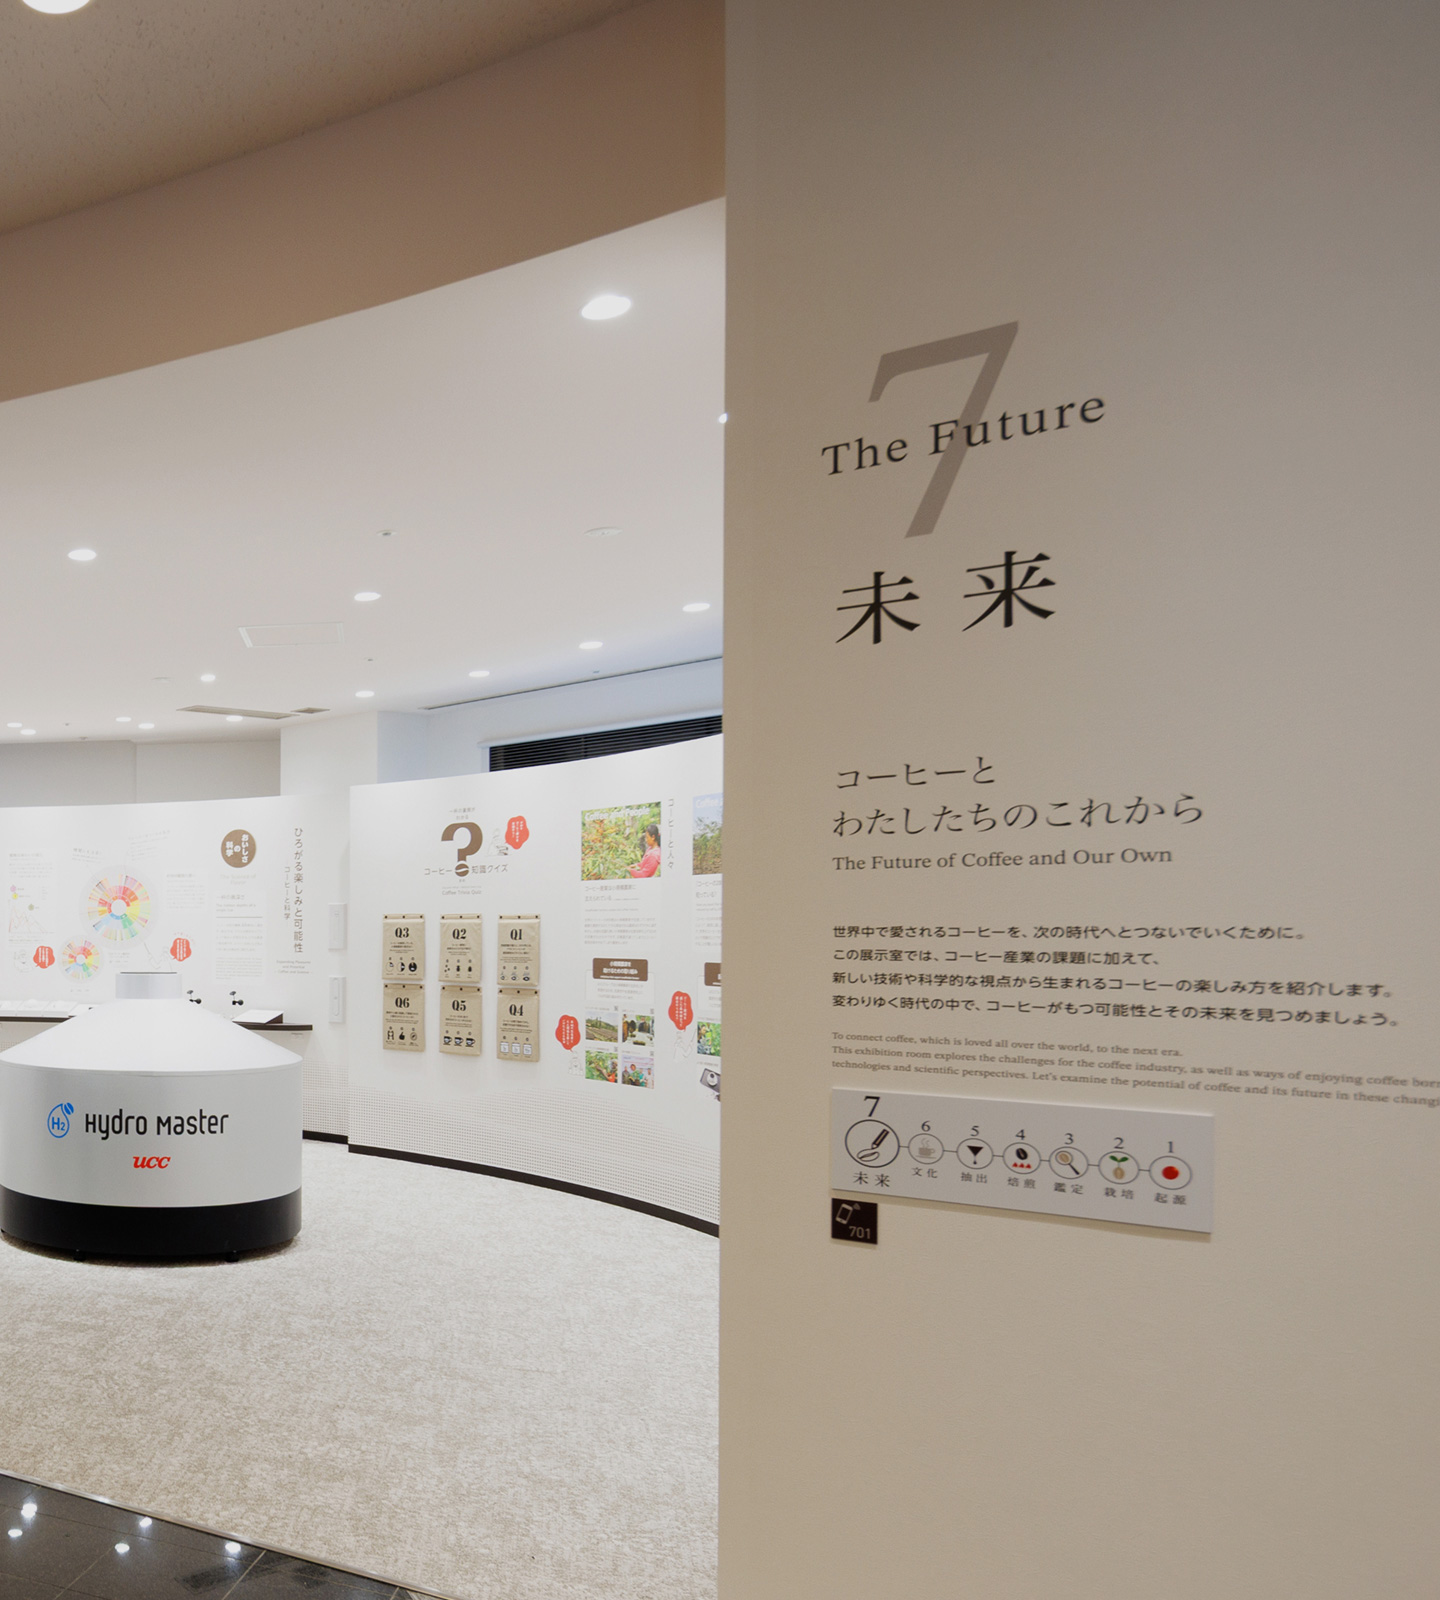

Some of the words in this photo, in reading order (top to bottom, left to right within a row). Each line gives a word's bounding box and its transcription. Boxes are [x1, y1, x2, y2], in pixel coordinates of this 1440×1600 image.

[821, 437, 909, 476] The
[928, 396, 1106, 456] Future
[868, 321, 1018, 539] 7
[835, 550, 1057, 644] 未来
[836, 756, 995, 789] コーヒーと
[585, 811, 609, 821] Coffee
[832, 793, 1203, 838] わたしたちのこれから
[241, 833, 249, 863] おいしさ
[832, 857, 866, 871] The
[871, 854, 932, 869] Future
[937, 853, 956, 868] of
[961, 852, 1023, 868] Coffee
[1029, 850, 1066, 866] and
[1073, 849, 1114, 865] Our
[1120, 848, 1173, 863] Own
[424, 867, 453, 876] コーヒー
[293, 827, 303, 953] ひろがる楽しみと可能性
[442, 888, 456, 896] Coffee
[395, 927, 410, 939] Q3
[452, 928, 467, 940] Q2
[510, 928, 522, 941] Q1
[833, 925, 1305, 940] 世界中で愛されるコーヒーを、次の時代へとつないでいくために。
[833, 949, 1160, 965] この展示室では、コーヒー産業の課題に加えて、
[832, 971, 1392, 998] 新しい技術や科学的な視点から生まれるコーヒーの楽しみ方を紹介します。
[395, 997, 410, 1009] Q6
[452, 1000, 467, 1011] Q5
[509, 1004, 524, 1016] Q4
[832, 995, 1398, 1027] 変わりゆく時代の中で、コーヒーがもつ可能性とその未来を見つめましょう。
[832, 1032, 843, 1040] To
[846, 1034, 882, 1042] connect
[885, 1034, 917, 1044] coffee,
[920, 1036, 950, 1046] which
[954, 1037, 962, 1046] is
[965, 1038, 992, 1047] loved
[995, 1039, 1008, 1048] all
[1037, 1041, 1055, 1050] the
[1057, 1043, 1093, 1053] world,
[1096, 1045, 1108, 1053] to
[1111, 1045, 1129, 1054] the
[1133, 1047, 1158, 1055] next
[1161, 1049, 1183, 1057] era.
[832, 1046, 852, 1054] This
[855, 1047, 903, 1057] exhibition
[906, 1051, 931, 1059] room
[934, 1052, 976, 1062] explores
[979, 1053, 995, 1062] the
[998, 1055, 1055, 1067] challenges
[1057, 1057, 1074, 1066] for
[1077, 1058, 1095, 1068] the
[1098, 1060, 1132, 1070] coffee
[1135, 1062, 1188, 1075] industry,
[1190, 1066, 1203, 1074] as
[1207, 1067, 1232, 1076] well
[1236, 1069, 1249, 1077] as
[1252, 1070, 1284, 1080] ways
[1287, 1071, 1302, 1080] of
[1305, 1073, 1363, 1086] enjoying
[1366, 1076, 1408, 1086] coffee
[832, 1061, 891, 1072] technologies
[893, 1064, 911, 1072] and
[914, 1065, 959, 1075] scientific
[962, 1068, 1029, 1080] perspectives.
[1060, 1075, 1108, 1084] examine
[1111, 1076, 1129, 1086] the
[1132, 1078, 1185, 1090] potential
[1188, 1081, 1201, 1090] of
[1204, 1083, 1240, 1093] coffee
[1244, 1085, 1268, 1095] and
[1272, 1087, 1288, 1096] its
[1291, 1088, 1331, 1098] future
[1336, 1090, 1349, 1100] in
[1353, 1092, 1389, 1103] these
[864, 1095, 881, 1117] 7
[85, 1108, 148, 1141] Hydro
[156, 1108, 229, 1135] Master
[921, 1120, 931, 1132] 6
[970, 1125, 980, 1137] 5
[1015, 1129, 1026, 1140] 4
[1064, 1133, 1074, 1145] 3
[1114, 1137, 1124, 1149] 2
[1168, 1141, 1174, 1153] 1
[853, 1171, 891, 1188] 未来
[912, 1167, 938, 1179] 文化
[961, 1172, 988, 1184] 抽出
[1007, 1177, 1036, 1190] 焙煎
[1054, 1182, 1084, 1195] 鑑定
[1104, 1187, 1134, 1200] 栽培
[1154, 1193, 1187, 1205] 起源
[849, 1225, 871, 1239] 701
